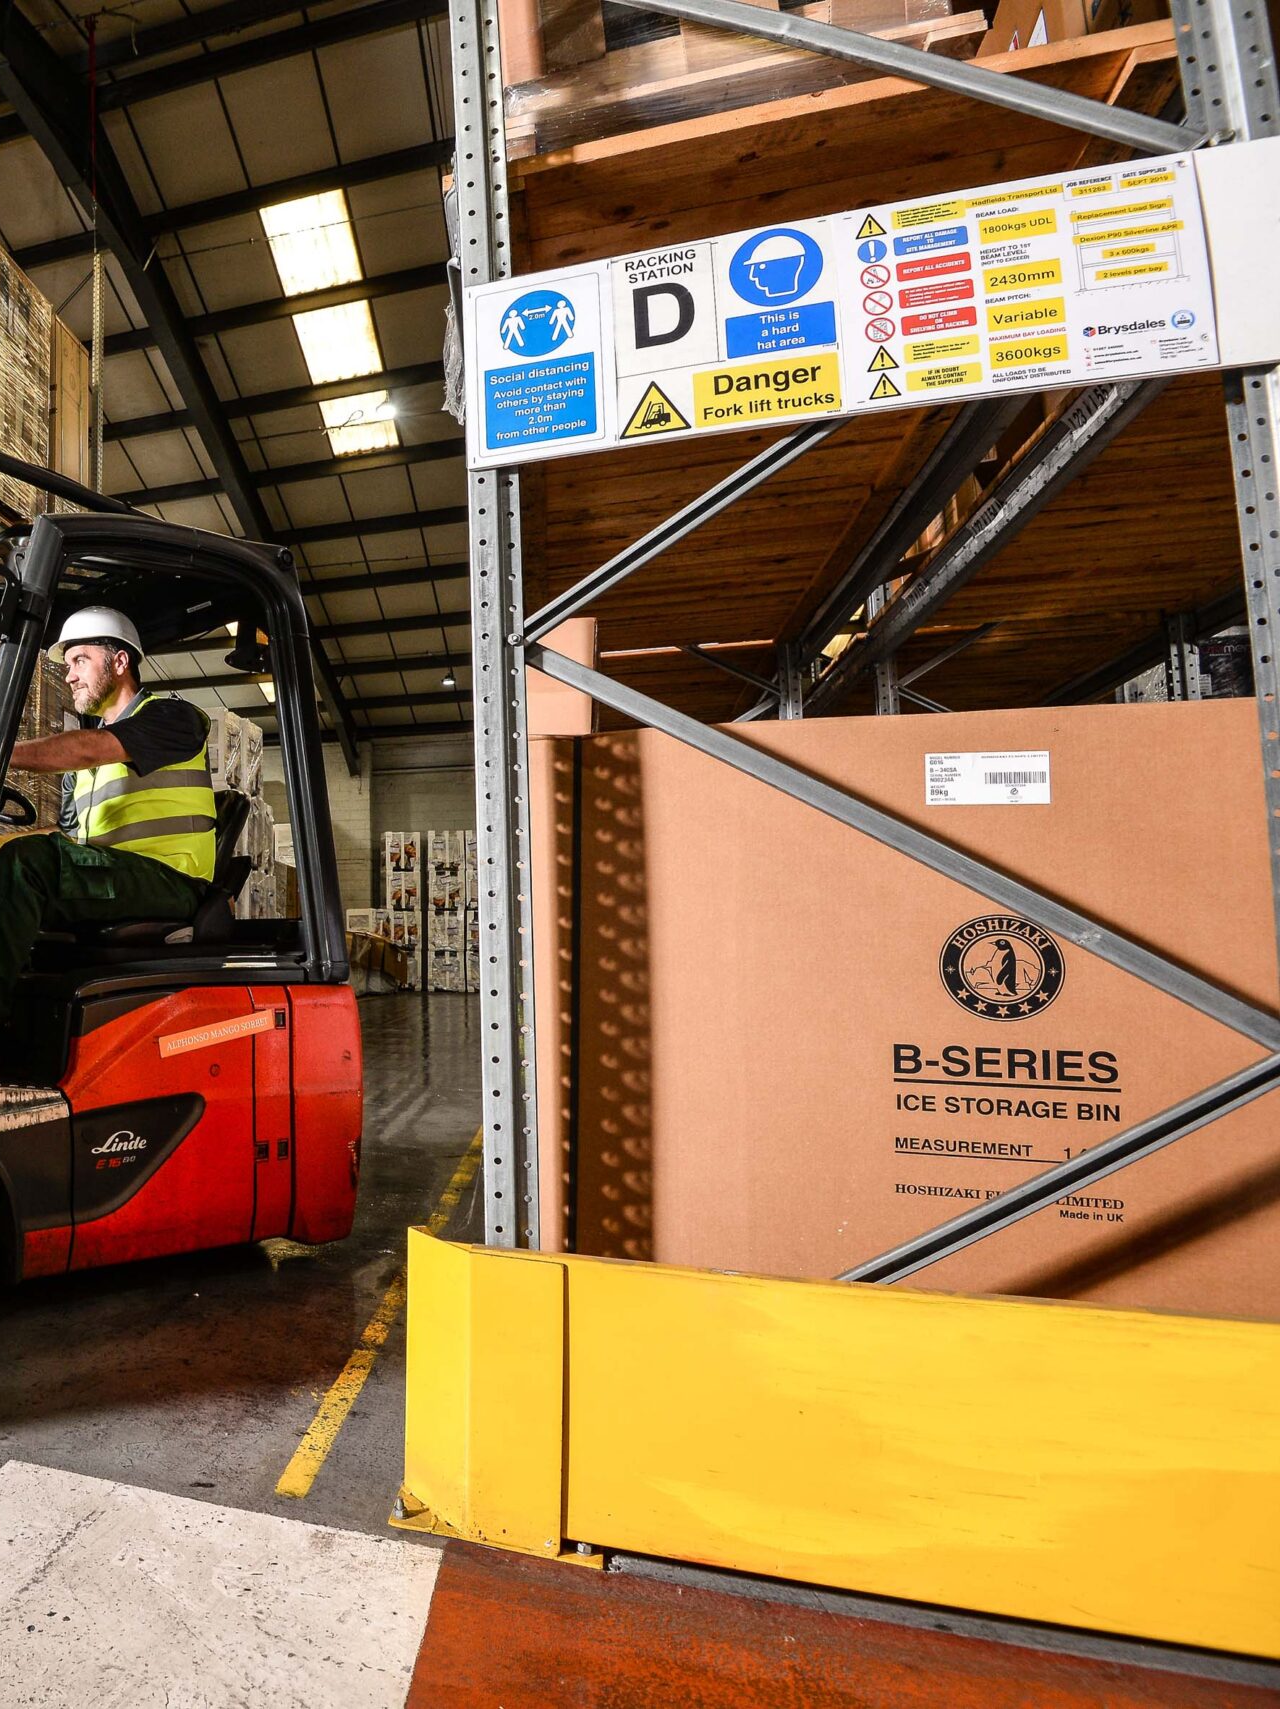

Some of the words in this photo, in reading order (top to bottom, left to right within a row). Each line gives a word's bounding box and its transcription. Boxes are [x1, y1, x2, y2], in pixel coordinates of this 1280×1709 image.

[1078, 176, 1112, 186] REFERENCE
[972, 197, 1006, 206] Hadfields
[1008, 190, 1044, 200] Transport
[976, 210, 996, 218] BEAM
[997, 206, 1019, 214] LOAD:
[1076, 208, 1127, 222] Replacement
[1128, 205, 1148, 213] Load
[1148, 202, 1167, 210] Sign
[982, 222, 1027, 234] 1800kgs
[1029, 217, 1052, 227] UDL
[1123, 226, 1160, 237] Silverline
[902, 233, 923, 243] REPORT
[924, 232, 934, 240] ALL
[934, 228, 958, 237] DAMAGE
[918, 240, 956, 252] MANAGEMENT
[980, 246, 1006, 255] HEIGHT
[980, 252, 1002, 260] BEAM
[1002, 248, 1028, 258] LEVEL:
[624, 248, 696, 273] RACKING
[902, 266, 924, 275] REPORT
[935, 260, 965, 270] ACCIDENTS
[628, 262, 694, 284] STATION
[990, 270, 1056, 287] 2430mm
[1110, 269, 1132, 278] levels
[1134, 268, 1146, 276] per
[1148, 265, 1164, 273] bay
[984, 296, 1006, 304] BEAM
[1007, 292, 1032, 302] PITCH:
[528, 312, 546, 321] 2.0m
[632, 282, 695, 350] D
[760, 312, 786, 325] This
[788, 310, 800, 320] is
[940, 310, 958, 318] CLIMB
[992, 308, 1058, 325] Variable
[761, 329, 769, 337] a
[772, 323, 799, 336] hard
[910, 324, 936, 334] SHELVING
[945, 320, 970, 328] RACKING
[988, 333, 1021, 342] MAXIMUM
[1036, 326, 1067, 336] LOADING
[1098, 319, 1166, 336] Brysdales
[757, 338, 777, 350] hat
[779, 336, 806, 348] area
[996, 346, 1062, 362] 3600kgs
[490, 370, 525, 386] Social
[528, 361, 590, 380] distancing
[921, 374, 942, 382] ALWAYS
[942, 371, 968, 379] CONTACT
[942, 366, 960, 374] DOUBT
[992, 374, 1028, 384] UNIFORMLY
[1030, 369, 1072, 378] DISTRIBUTED
[494, 387, 522, 400] Avoid
[524, 382, 563, 394] contact
[566, 376, 587, 388] with
[713, 365, 822, 396] Danger
[938, 378, 964, 386] SUPPLIER
[496, 398, 529, 410] others
[531, 394, 544, 405] by
[546, 388, 585, 402] staying
[703, 402, 744, 420] Fork
[748, 399, 772, 414] lift
[776, 391, 835, 410] trucks
[514, 406, 542, 418] more
[543, 402, 566, 412] than
[528, 415, 554, 425] 2.0m
[496, 430, 520, 441] from
[522, 426, 549, 438] other
[551, 418, 587, 434] people
[951, 917, 1053, 952] HOSHIZAKI
[166, 1033, 210, 1052] ALPHONSO
[210, 1024, 240, 1039] MANGO
[240, 1016, 268, 1032] SORBET
[892, 1043, 1120, 1084] B-SERIES
[896, 1094, 937, 1113] ICE
[944, 1096, 1069, 1120] STORAGE
[1076, 1104, 1121, 1122] BIN
[91, 1130, 147, 1154] Linde
[894, 1136, 1034, 1157] MEASUREMENT
[894, 1184, 980, 1200] HOSHIZAKI
[1055, 1196, 1125, 1210] LIMITED
[1059, 1210, 1090, 1220] Made
[1092, 1212, 1104, 1221] in
[1107, 1213, 1124, 1223] UK
